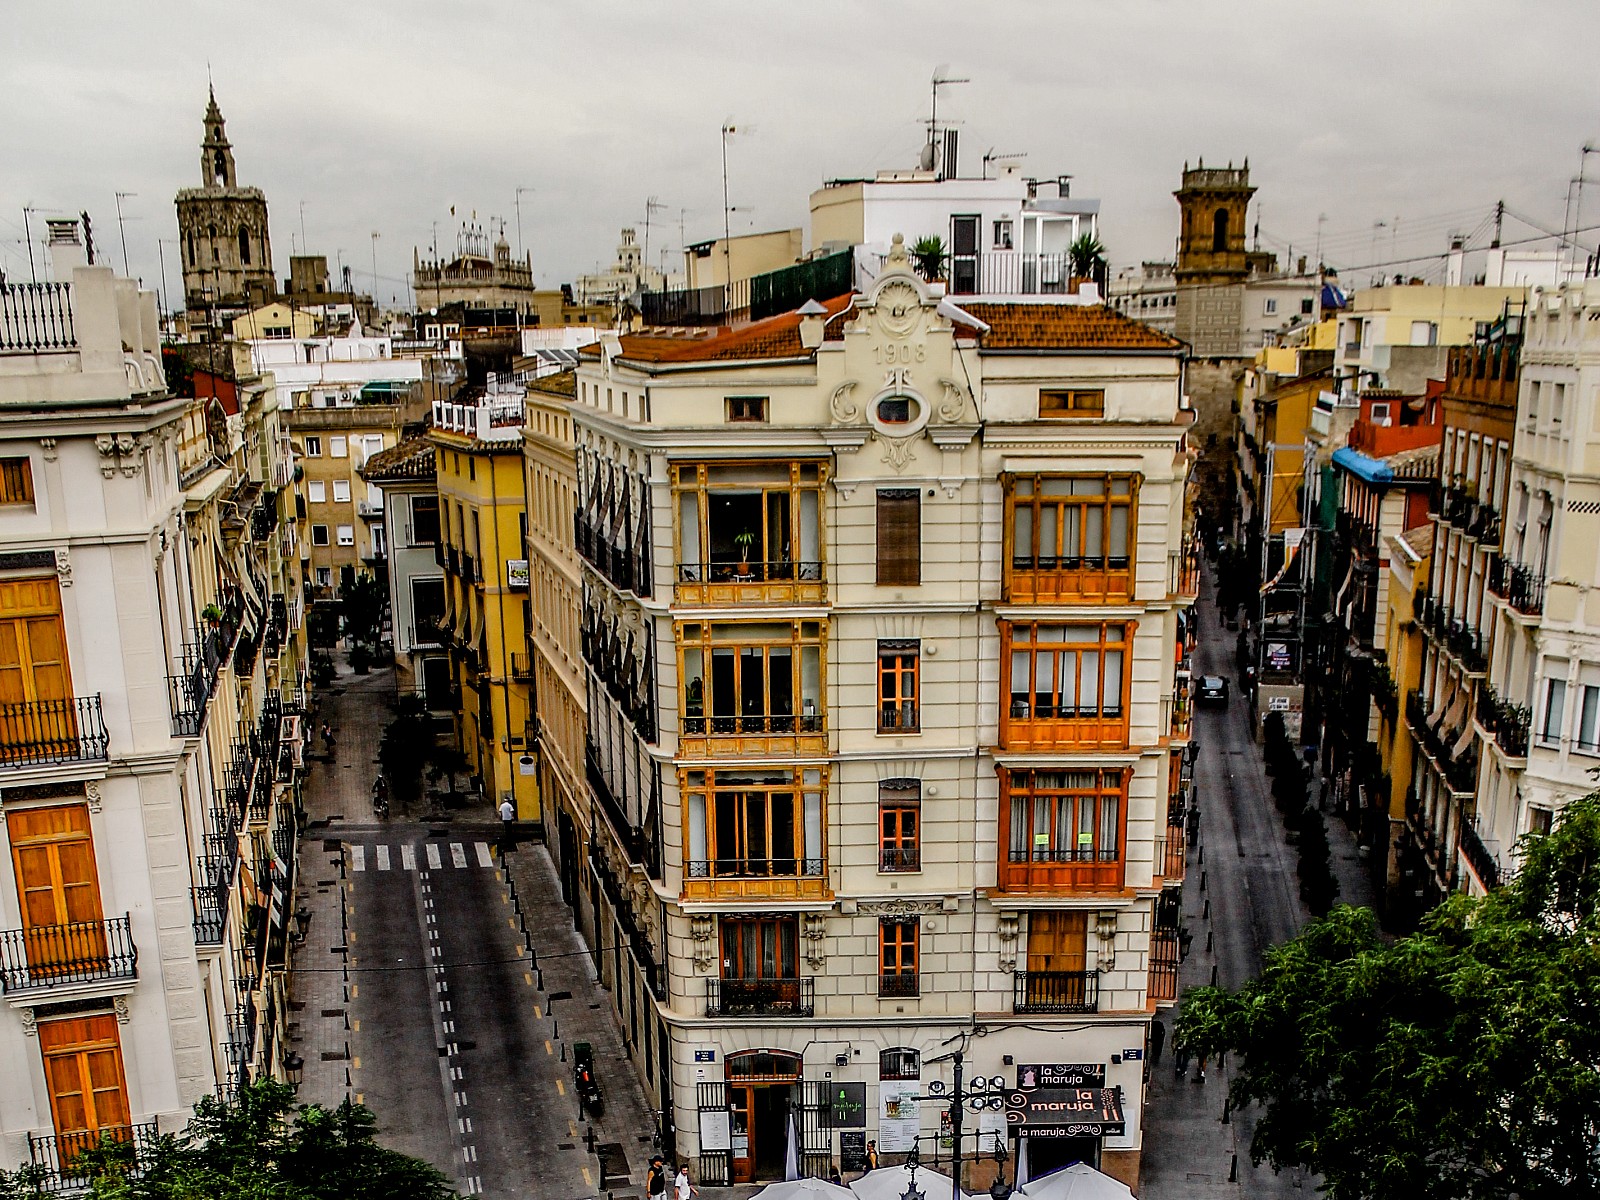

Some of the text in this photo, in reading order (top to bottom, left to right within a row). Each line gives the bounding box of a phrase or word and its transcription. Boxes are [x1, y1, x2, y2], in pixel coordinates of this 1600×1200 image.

[872, 344, 927, 364] 1908
[1041, 1065, 1052, 1076] la
[1040, 1074, 1083, 1086] maruja
[1075, 1089, 1093, 1100] la
[1030, 1100, 1094, 1112] maruja
[1018, 1127, 1066, 1138] la maruja
